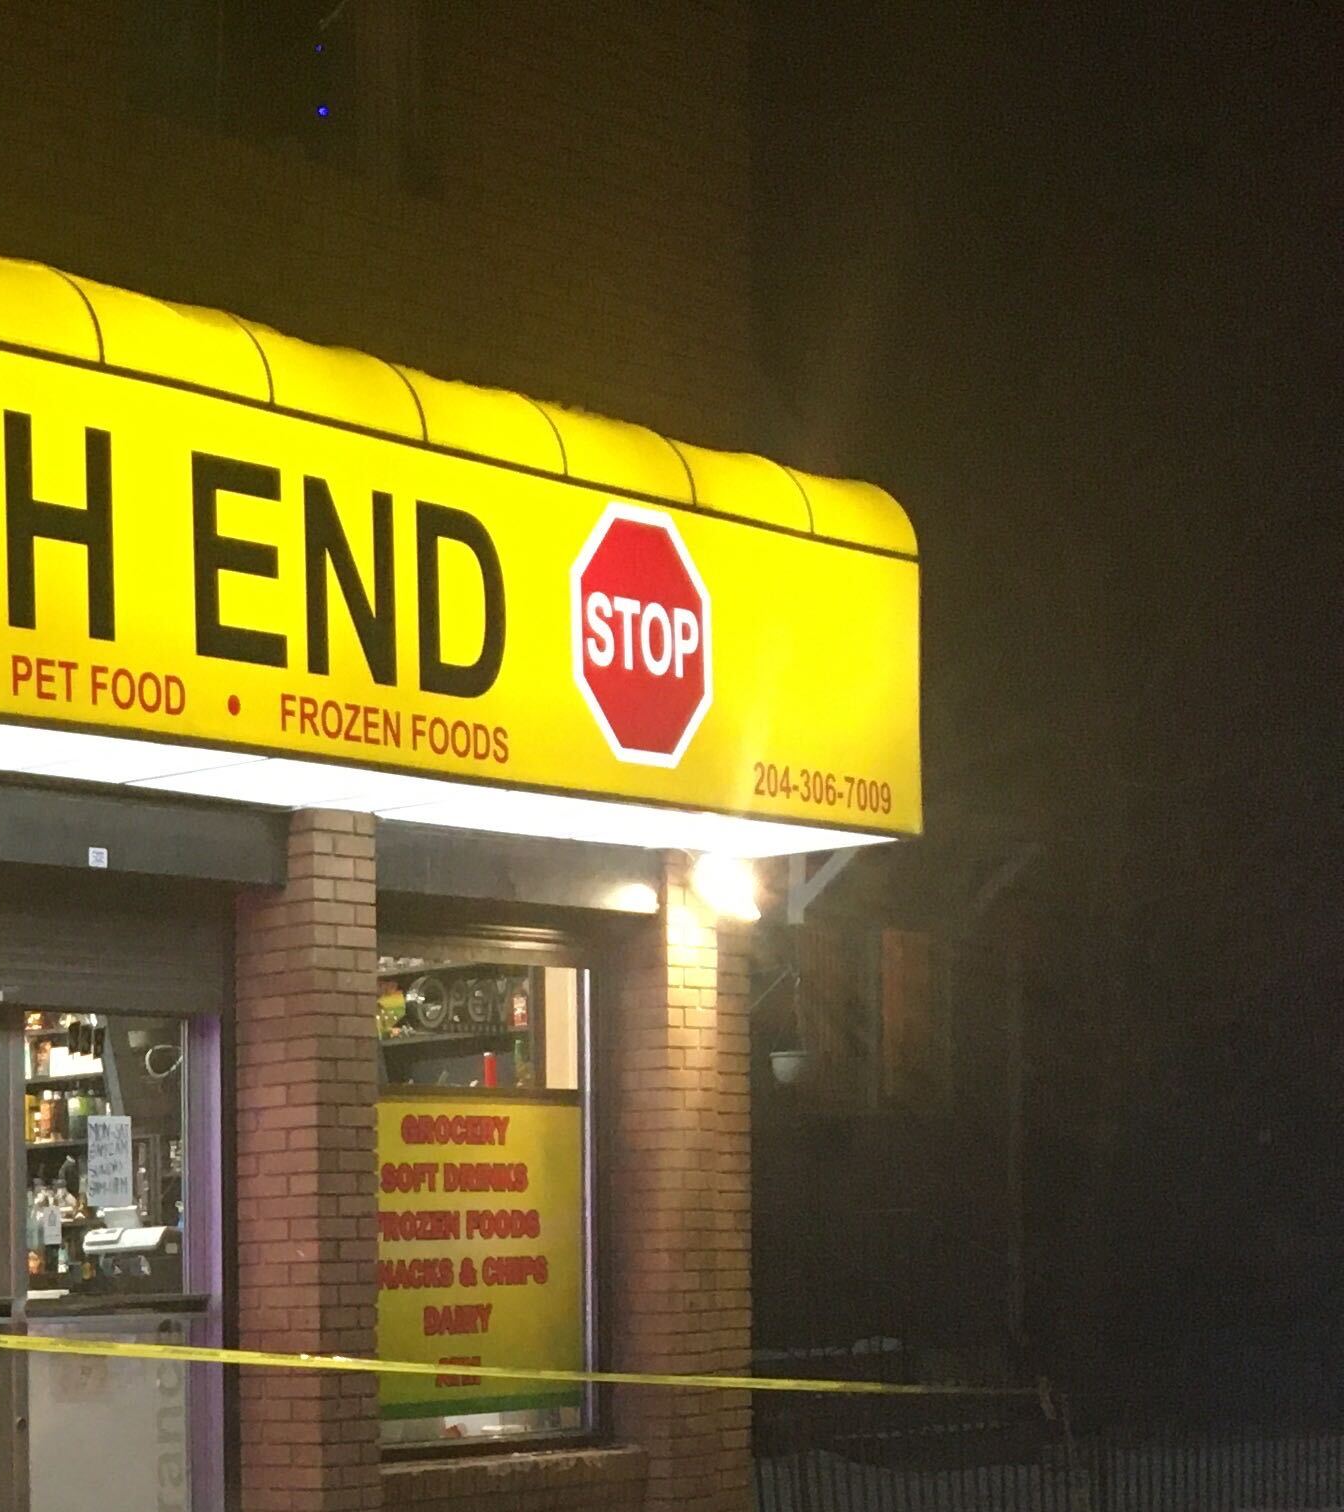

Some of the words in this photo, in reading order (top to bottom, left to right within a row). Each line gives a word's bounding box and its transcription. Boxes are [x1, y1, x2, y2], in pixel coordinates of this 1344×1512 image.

[191, 451, 506, 699] END
[586, 592, 699, 679] STOP
[11, 654, 79, 702] PET
[90, 665, 187, 717] FOOD
[280, 693, 402, 749] FROZEN
[410, 712, 509, 765] FOODS
[753, 762, 893, 815] 204-306-7009
[401, 1114, 510, 1146] GROCERY
[380, 1162, 440, 1194] SOFT
[443, 1162, 530, 1193] DRINKS
[466, 1208, 541, 1240] FOODS
[378, 1256, 454, 1290] NACKS
[482, 1254, 549, 1287] CHIPS
[423, 1302, 493, 1336] DAIRY
